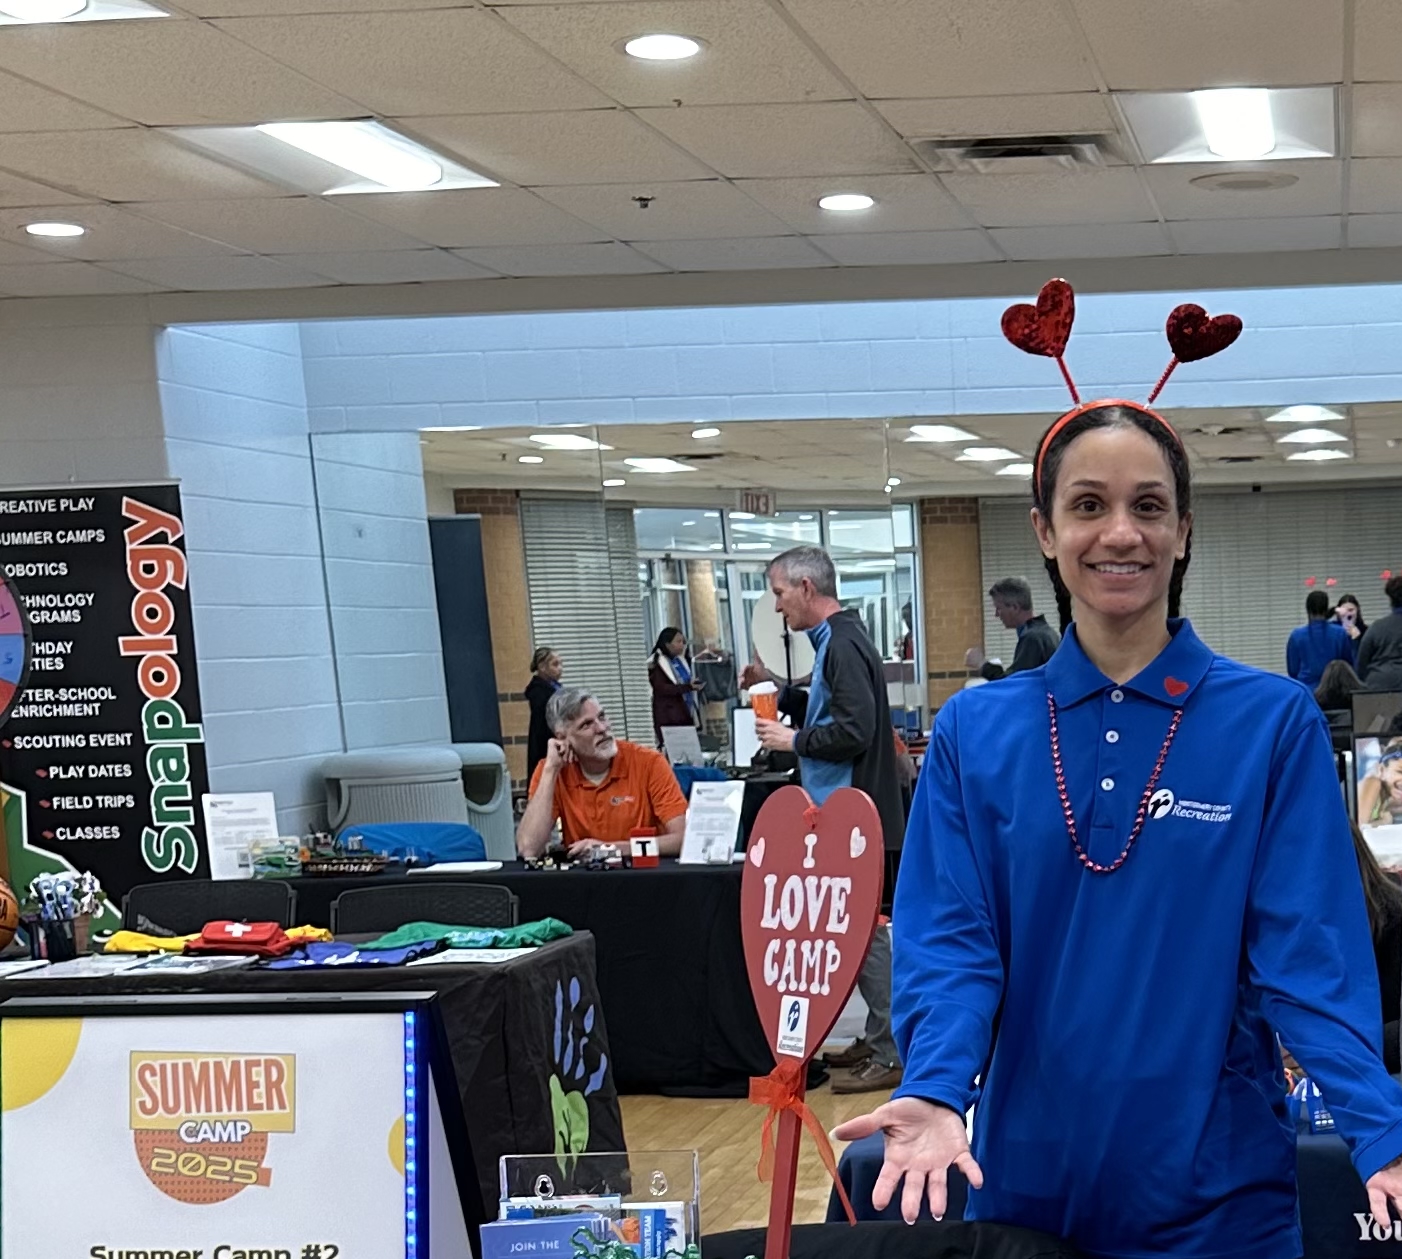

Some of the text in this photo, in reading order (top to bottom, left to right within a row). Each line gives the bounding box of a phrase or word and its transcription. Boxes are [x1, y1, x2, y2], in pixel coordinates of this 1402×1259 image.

[0, 497, 95, 514] REATIVE PLAY
[0, 528, 105, 546] UMMER CAMPS
[4, 562, 68, 577] OBOTICS
[22, 593, 95, 608] HNOLOGY
[28, 610, 81, 624] GRAMS
[32, 641, 73, 655] HDAY
[30, 657, 64, 671] TIES
[117, 496, 204, 874] Snapology
[13, 733, 133, 749] SCOUTING EVENT
[49, 764, 132, 779] PLAY DATES
[52, 795, 135, 810] FIELD TRIPS
[1171, 805, 1233, 822] Recreation
[56, 826, 120, 840] CLASSES
[804, 833, 818, 869] I
[760, 874, 852, 934] LOVE
[763, 938, 841, 996] CAMP
[137, 1057, 288, 1117] SUMMER
[178, 1120, 252, 1144] CAMP
[150, 1147, 260, 1185] 2025
[510, 1240, 560, 1253] JOIN THE
